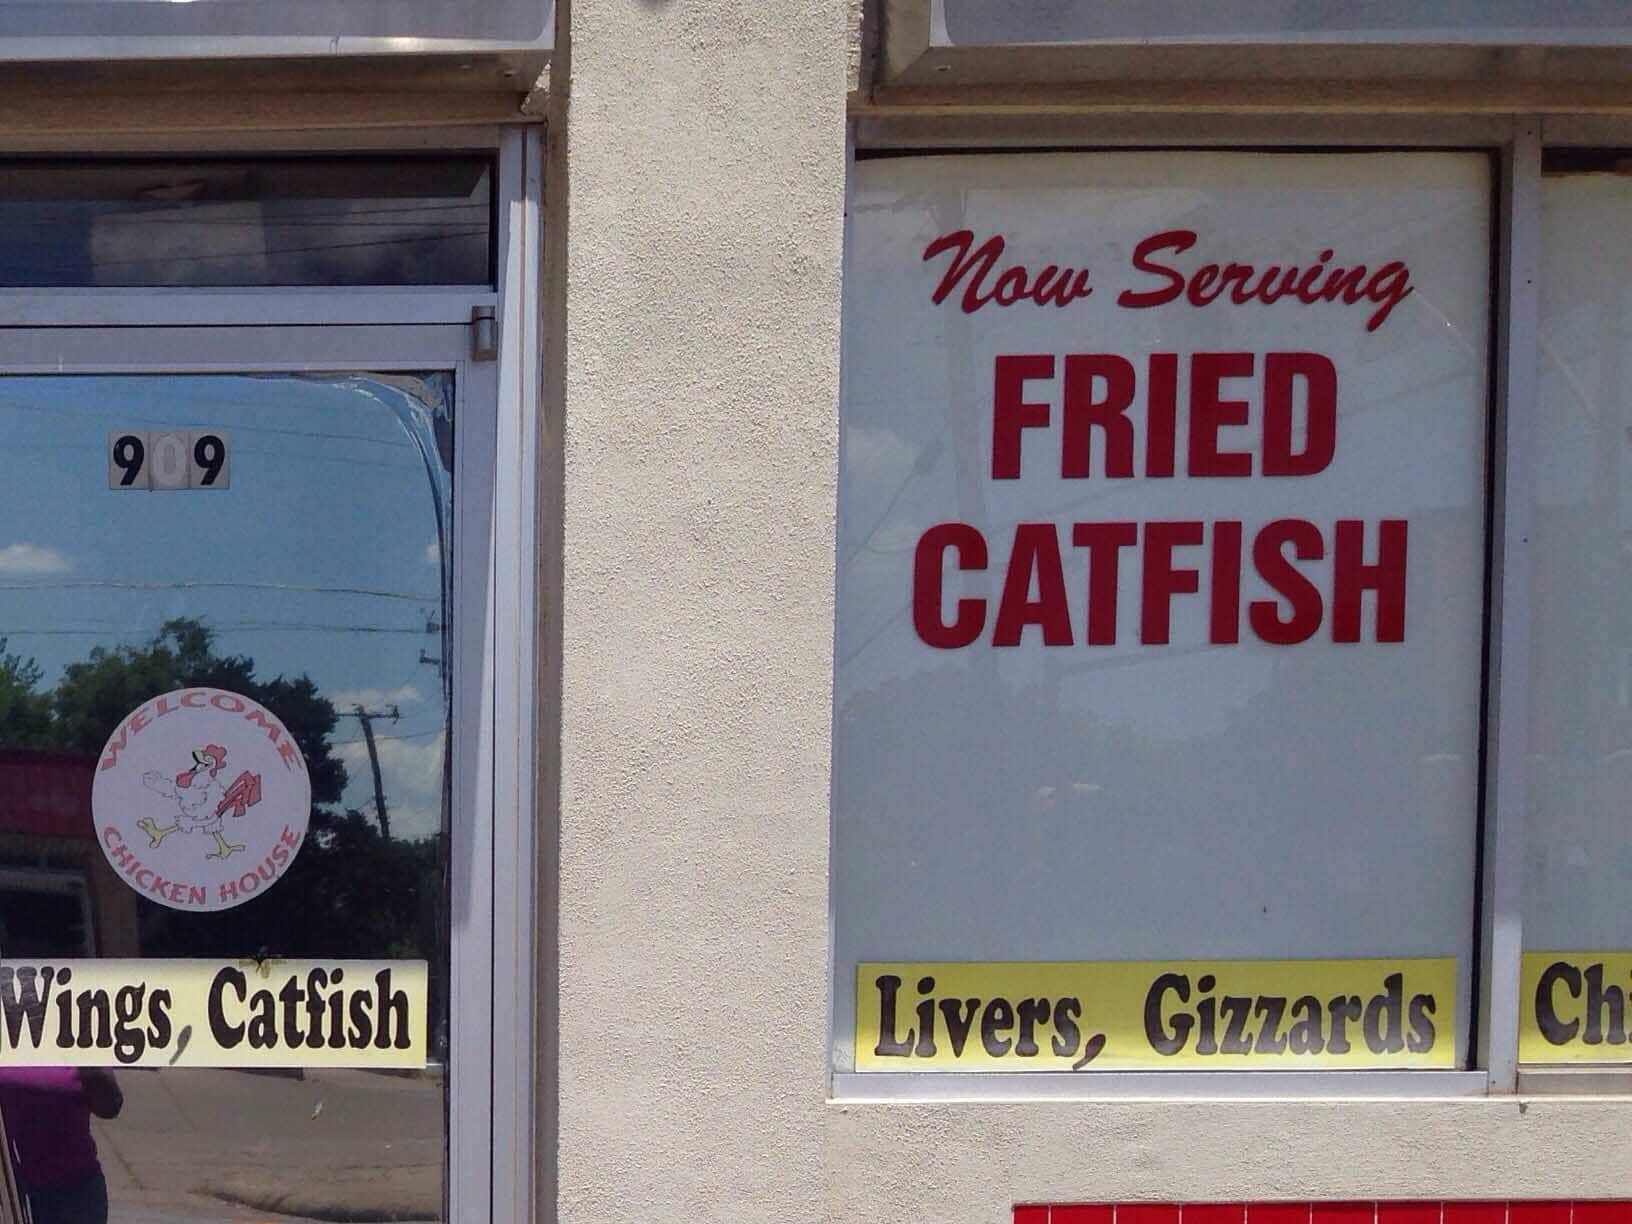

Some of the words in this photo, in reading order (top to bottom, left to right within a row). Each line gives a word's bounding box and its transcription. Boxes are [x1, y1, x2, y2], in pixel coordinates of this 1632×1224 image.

[922, 229, 1093, 314] Now
[1117, 229, 1414, 333] Serving
[991, 352, 1338, 480] FRIED
[912, 519, 1409, 650] CATFISH
[100, 691, 304, 772] WELCOME
[102, 826, 208, 906] CHICKEN
[218, 824, 301, 904] HOUSE
[207, 966, 412, 1050] Catfish
[873, 974, 1107, 1071] Livers,
[1143, 972, 1438, 1058] Gizzards
[1534, 960, 1632, 1046] Ch
